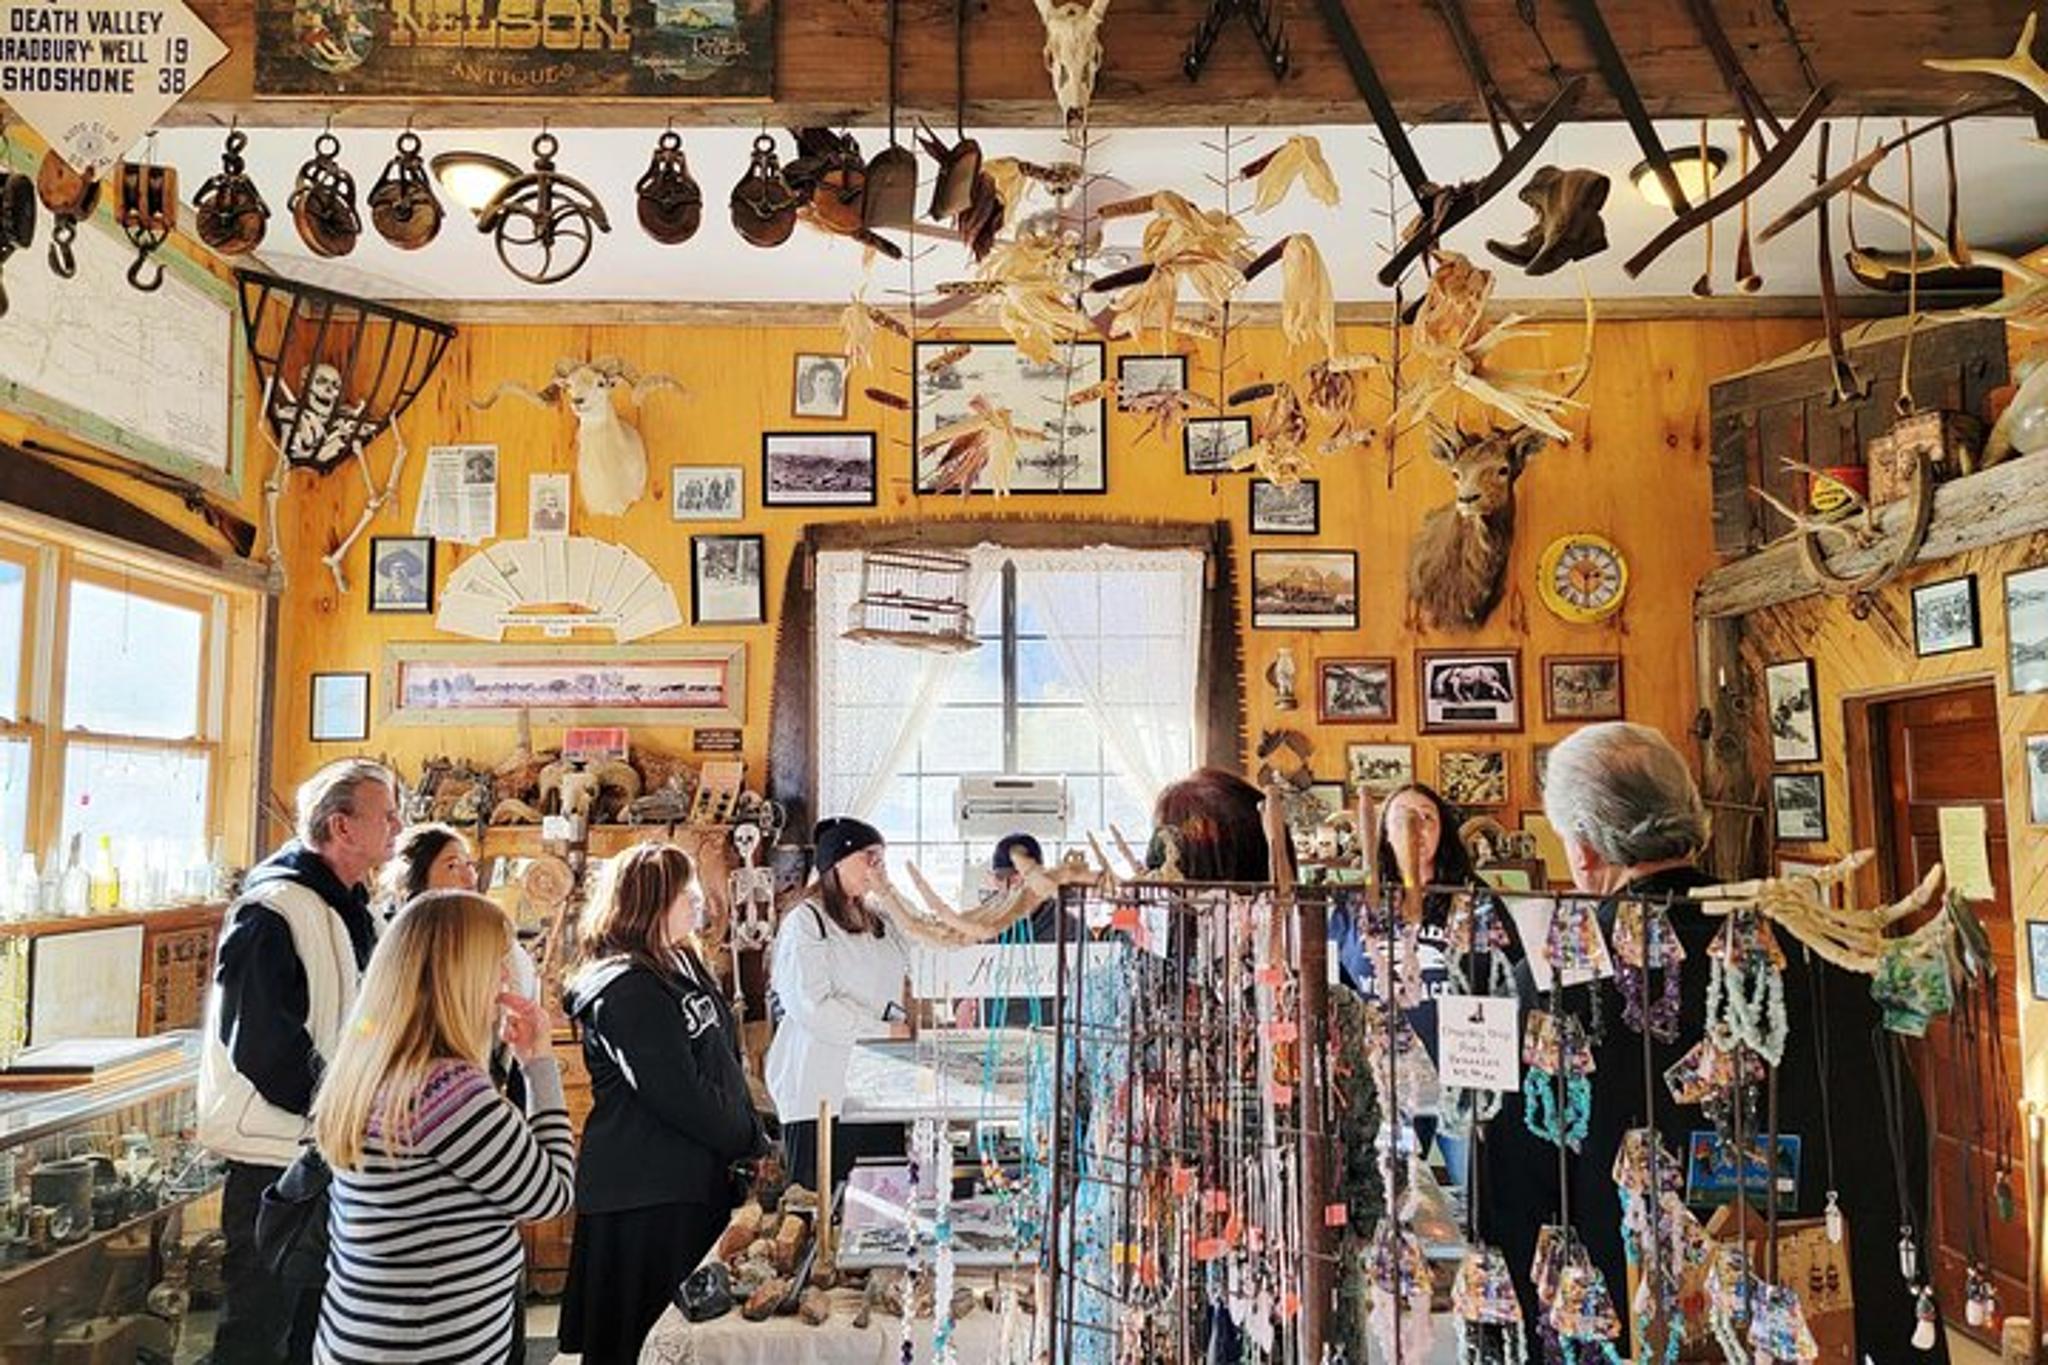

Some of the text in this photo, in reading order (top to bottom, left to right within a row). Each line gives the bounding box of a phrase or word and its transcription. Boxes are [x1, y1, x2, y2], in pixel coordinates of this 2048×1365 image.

[11, 9, 163, 34] DEATH VALLEY
[389, 0, 631, 49] NELSON
[101, 40, 148, 63] WELL
[166, 38, 188, 63] 19
[3, 66, 186, 94] SHOSHONE 38
[452, 60, 575, 86] ANTIQUES
